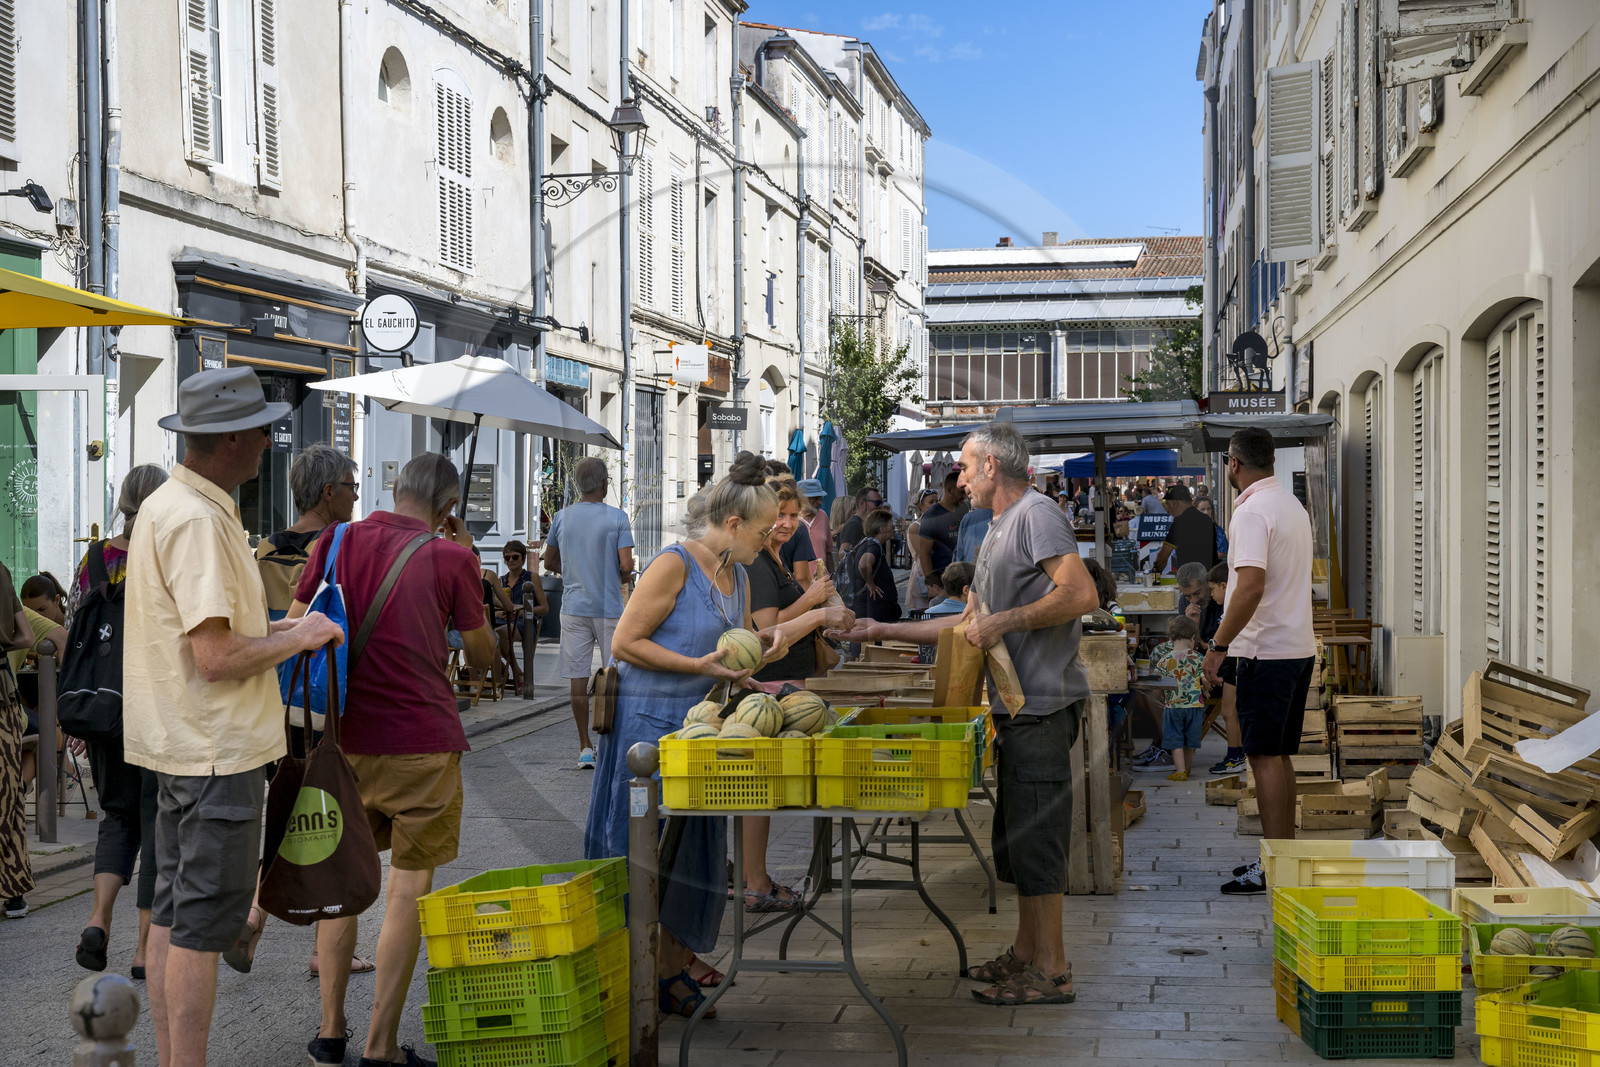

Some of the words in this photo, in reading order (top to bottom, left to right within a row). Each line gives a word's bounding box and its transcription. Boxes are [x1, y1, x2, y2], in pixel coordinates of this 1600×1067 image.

[365, 318, 374, 328] EL
[377, 318, 415, 328] GAUCHITO
[1228, 395, 1276, 408] MUSÉE
